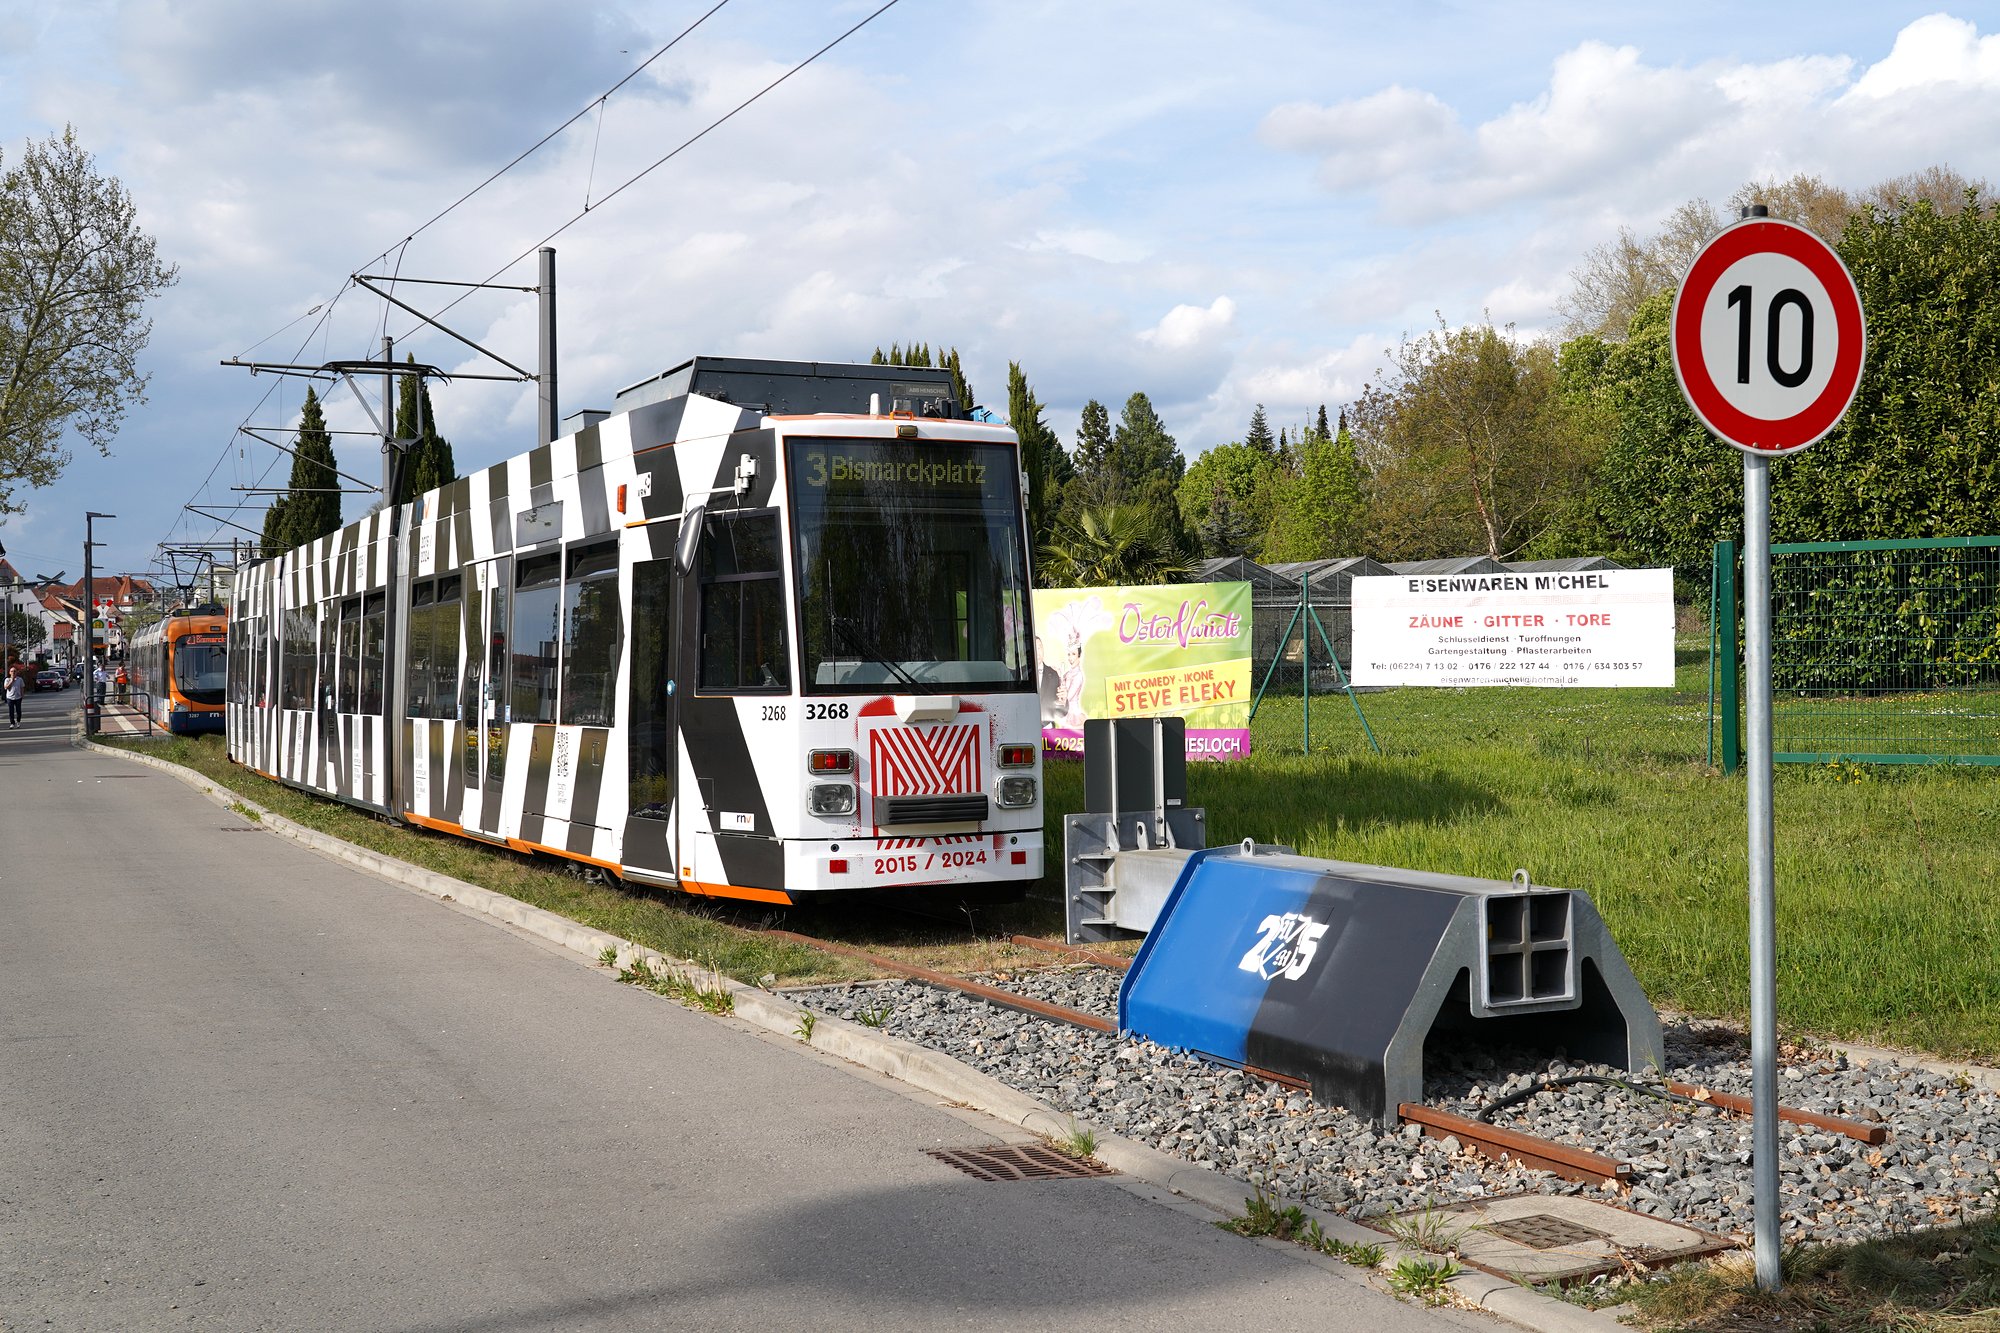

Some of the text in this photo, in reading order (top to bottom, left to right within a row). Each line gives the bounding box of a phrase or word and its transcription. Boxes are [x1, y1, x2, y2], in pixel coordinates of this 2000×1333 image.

[1728, 284, 1814, 388] 10
[806, 452, 986, 487] 3 Bismarckplatz
[1408, 613, 1611, 628] ZÄUNE GITTER TORE
[1428, 646, 1592, 657] Gartengestaltung Pflasterarbeiten
[1371, 662, 1387, 670] Tel:
[1389, 662, 1423, 671] (06224)
[1426, 662, 1431, 670] 7
[1447, 662, 1458, 670] 02
[1468, 662, 1491, 670] 0176
[1499, 662, 1516, 670] 222
[1520, 662, 1536, 670] 127
[1538, 662, 1550, 670] 44
[1563, 662, 1585, 670] 0176
[1594, 662, 1611, 670] 634
[1613, 662, 1630, 670] 303
[1632, 662, 1643, 670] 57
[1114, 681, 1131, 692] MIT
[1133, 675, 1176, 690] COMEDY
[1184, 669, 1214, 683] IKONE
[1115, 679, 1236, 712] STEVE ELEKY
[761, 705, 786, 721] 3268
[806, 703, 849, 720] 3268
[1041, 736, 1084, 752] IL 2025
[1184, 737, 1241, 753] IESLOCH
[736, 814, 752, 824] rnv
[874, 850, 987, 875] 2015 / 2024
